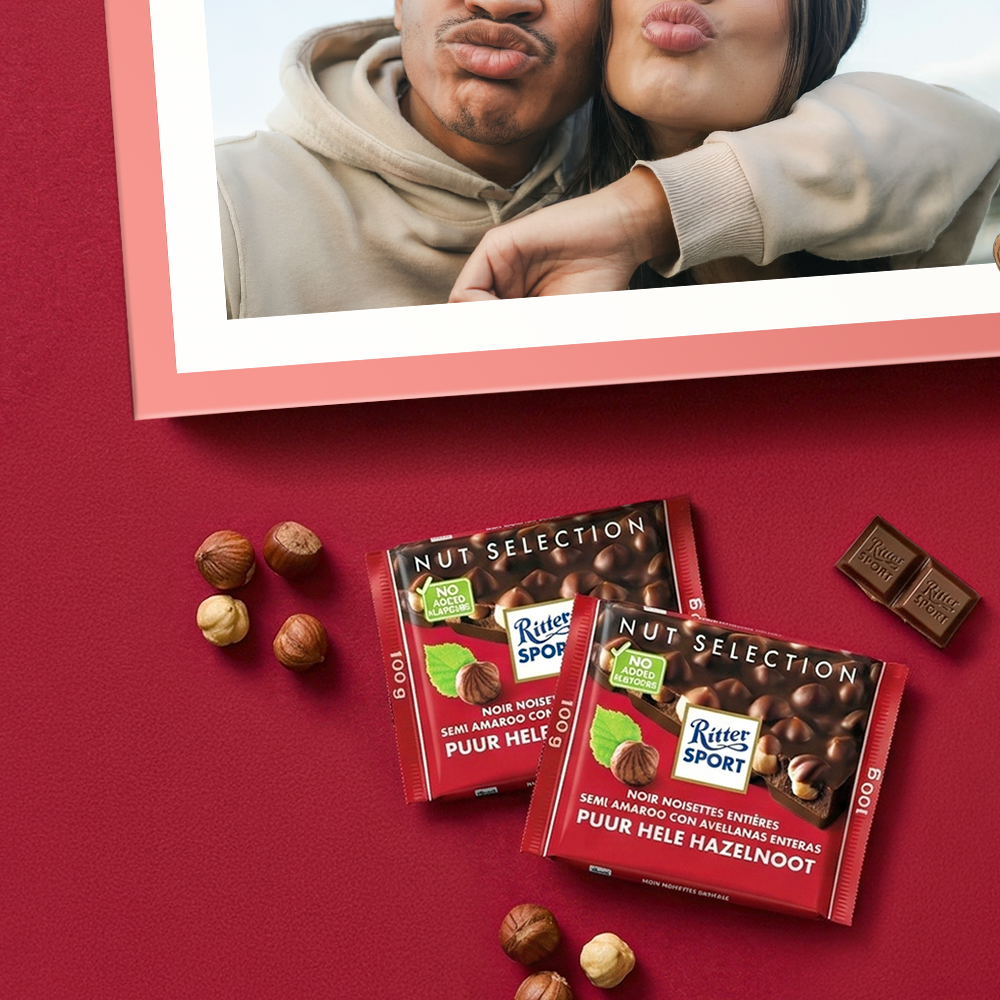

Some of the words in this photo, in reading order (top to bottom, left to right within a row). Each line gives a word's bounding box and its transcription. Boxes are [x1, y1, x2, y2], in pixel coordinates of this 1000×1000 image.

[413, 547, 469, 573] NUT
[486, 516, 645, 561] SELECTION
[436, 584, 459, 598] NO
[513, 611, 570, 646] Ritter
[618, 616, 678, 645] NUT
[693, 633, 858, 685] SELECTION
[629, 655, 652, 669] NO
[481, 702, 513, 717] NOIR
[441, 723, 469, 738] SEMI
[471, 713, 526, 732] AMAROO
[687, 717, 751, 752] Ritter
[445, 734, 501, 758] PUUR
[683, 747, 746, 775] SPORT
[626, 789, 659, 805] NOIR
[661, 796, 724, 818] NOISETTES
[579, 792, 609, 808] SEMI
[611, 799, 667, 820] AMAROO
[669, 812, 697, 827] CON
[698, 818, 767, 843] AVELLANAS
[769, 834, 822, 855] ENTERAS
[576, 808, 632, 835] PUUR
[637, 821, 685, 847] HELE
[689, 833, 816, 875] HAZELNOOT
